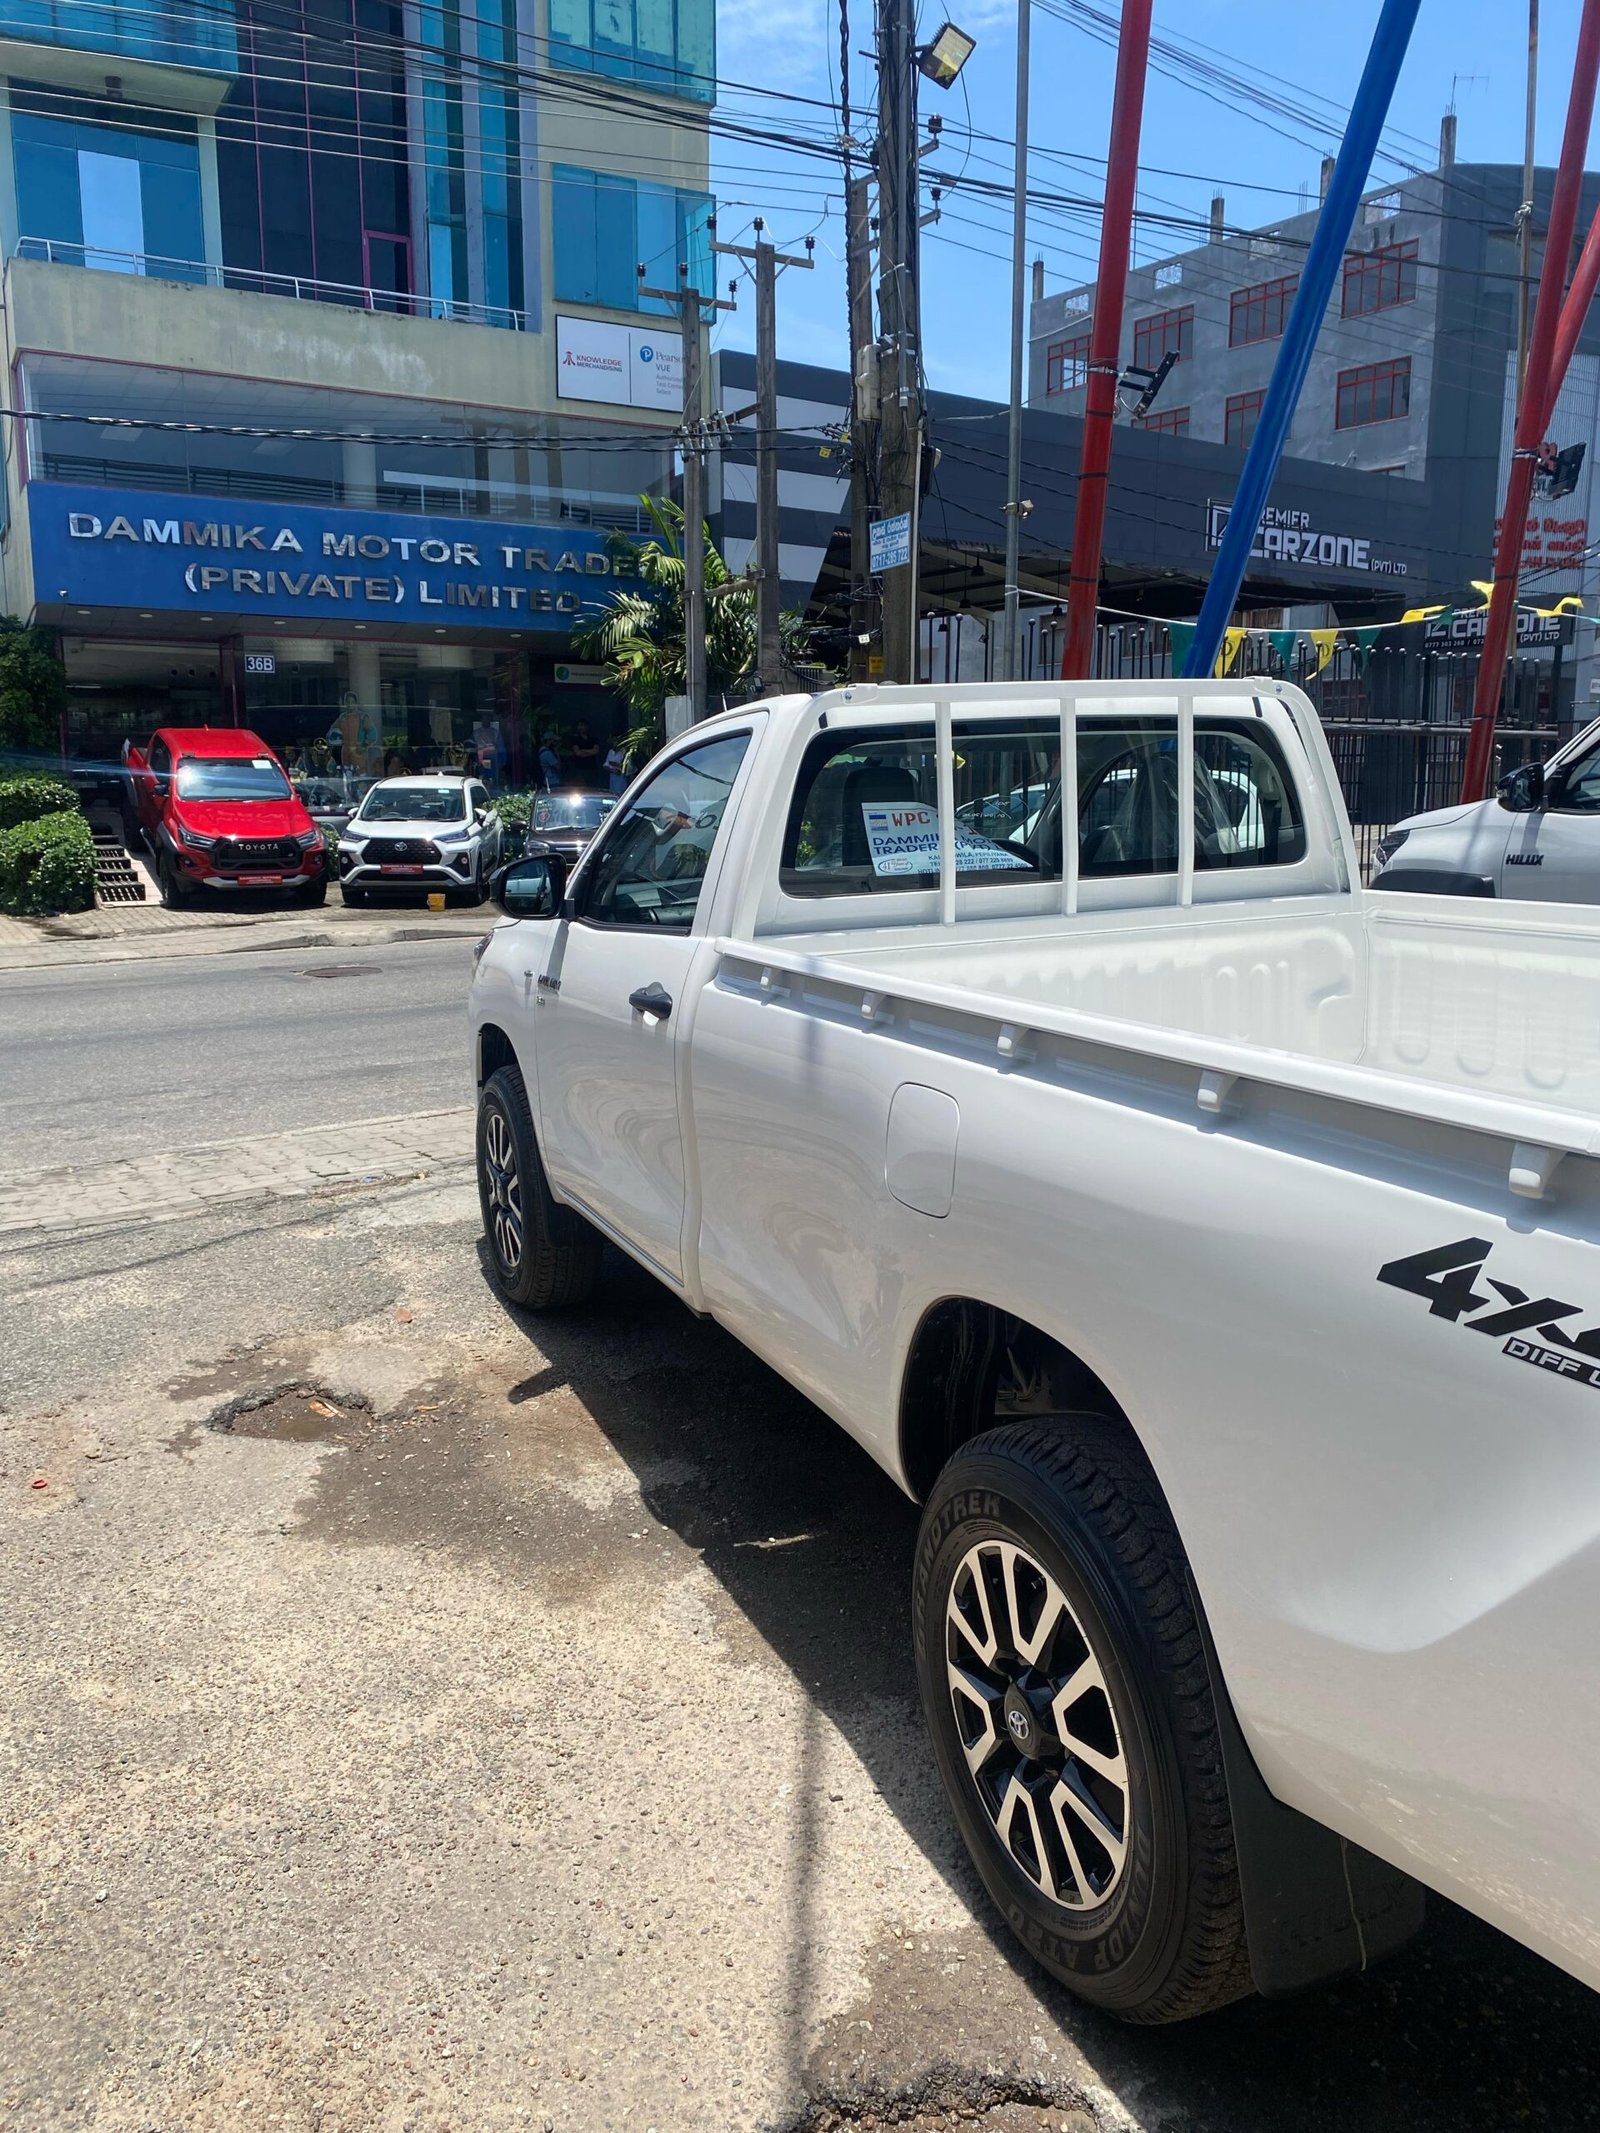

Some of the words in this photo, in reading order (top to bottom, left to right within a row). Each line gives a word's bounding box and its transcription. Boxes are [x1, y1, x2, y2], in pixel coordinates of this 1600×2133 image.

[576, 354, 622, 367] KNOWLEDGE
[576, 361, 622, 373] MERCHANDISING
[656, 363, 671, 372] VUE
[1261, 506, 1310, 528] REMIER
[68, 512, 304, 553] DAMMIKA
[322, 531, 482, 567] MOTOR
[501, 546, 635, 578] TRADE
[1250, 526, 1371, 570] CARZONE
[1371, 558, 1391, 573] (PVT)
[1393, 560, 1407, 575] LTD
[184, 562, 405, 604] (PRIVATE)
[419, 580, 582, 613] LIMITED
[1454, 608, 1489, 619] PREMI
[1520, 631, 1542, 644] (PVT)
[1544, 630, 1560, 641] LTD
[247, 656, 273, 671] 36B
[892, 811, 931, 827] WPC
[873, 833, 940, 846] DAMMI
[238, 843, 280, 851] TOYOTA
[873, 842, 939, 855] TRADER
[1505, 854, 1544, 866] HILUX
[1506, 1340, 1582, 1373] DIFF
